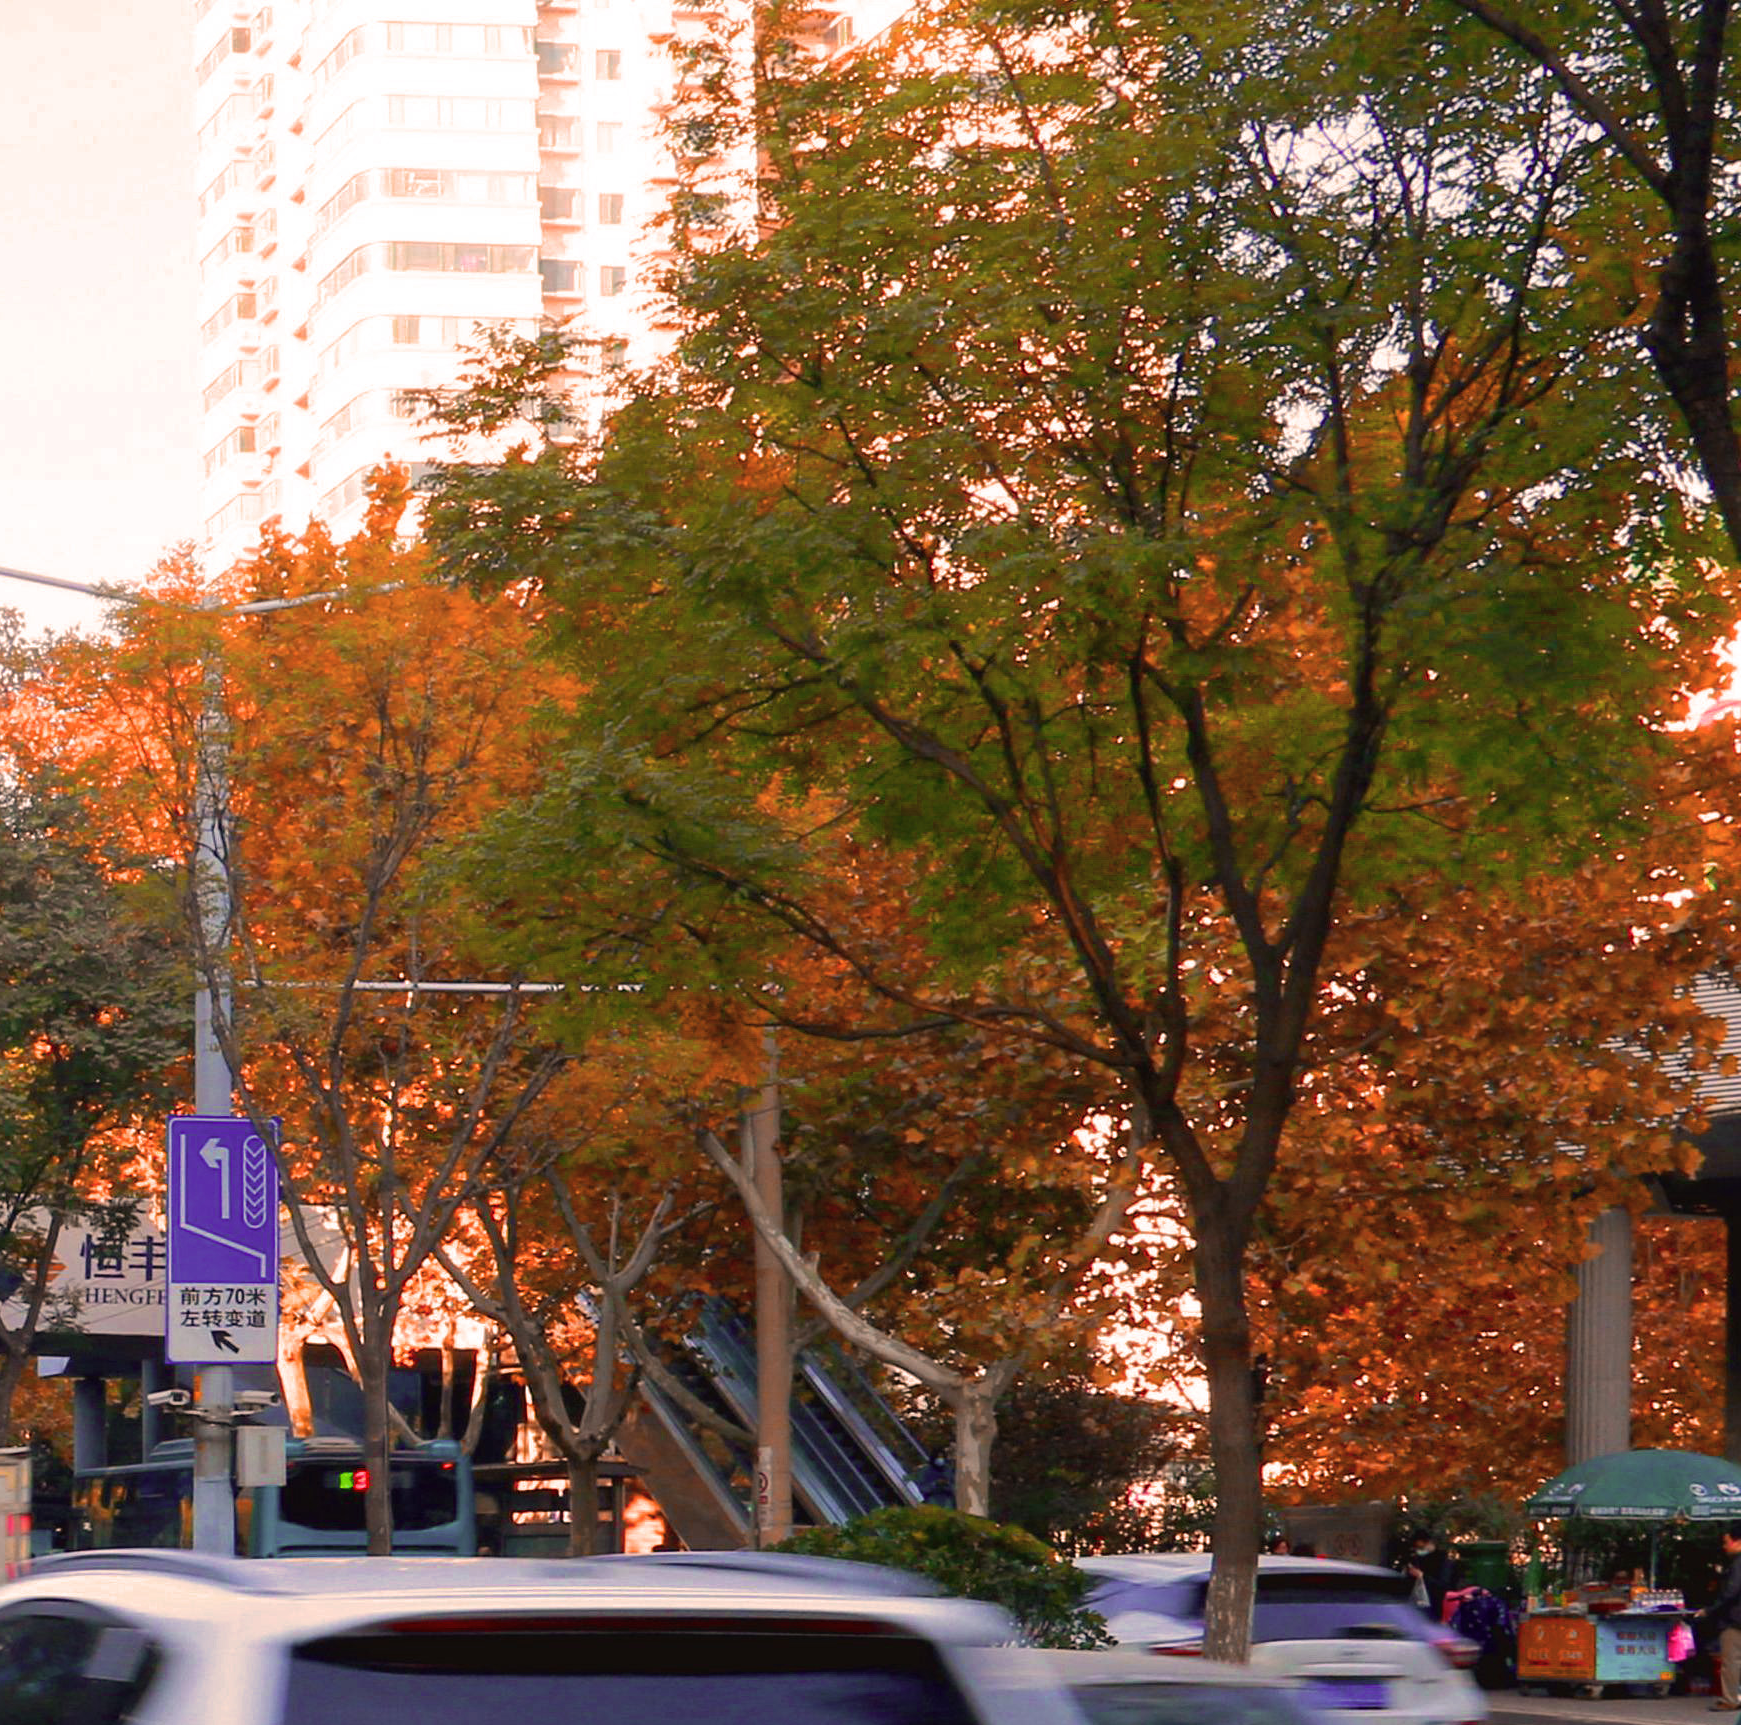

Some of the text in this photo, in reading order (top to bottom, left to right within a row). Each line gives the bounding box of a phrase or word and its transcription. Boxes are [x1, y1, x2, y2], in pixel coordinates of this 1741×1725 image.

[180, 1287, 267, 1306] 前方70米
[180, 1309, 267, 1328] 左转变道
